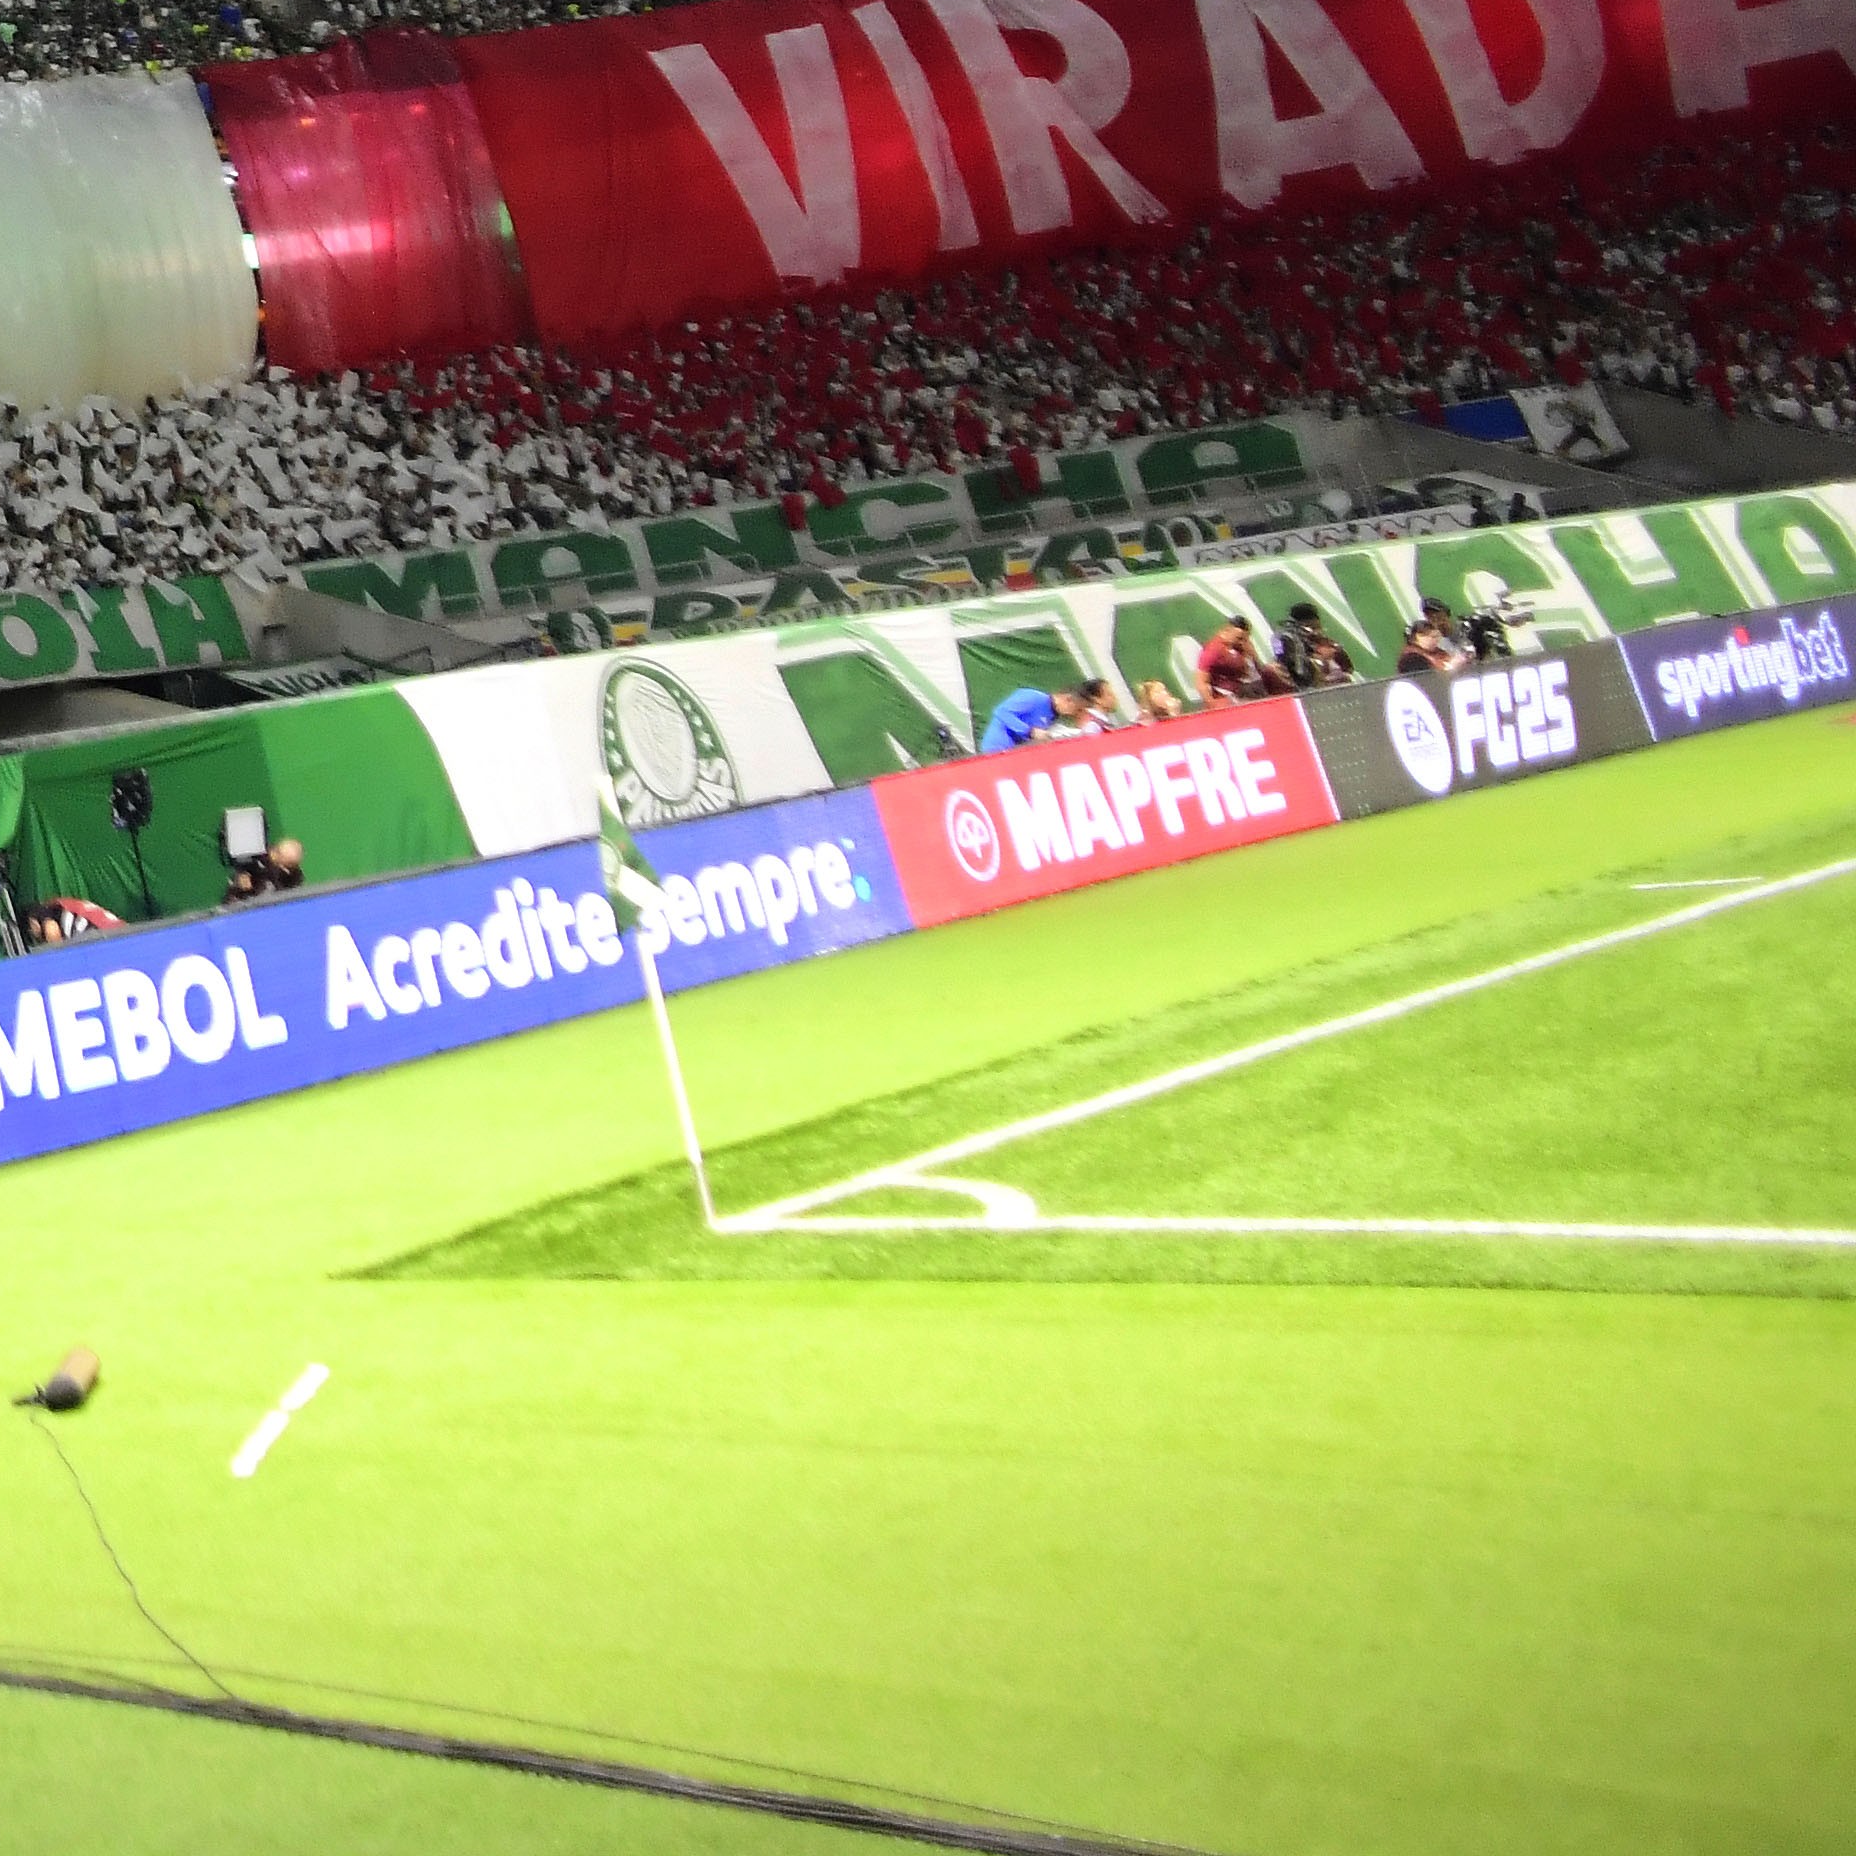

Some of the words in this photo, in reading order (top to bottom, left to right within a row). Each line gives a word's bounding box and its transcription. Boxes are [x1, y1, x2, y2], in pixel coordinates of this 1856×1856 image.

[1657, 612, 1852, 718] sportingbet
[996, 727, 1288, 873] MAPFRE
[324, 875, 623, 1030] Acredite
